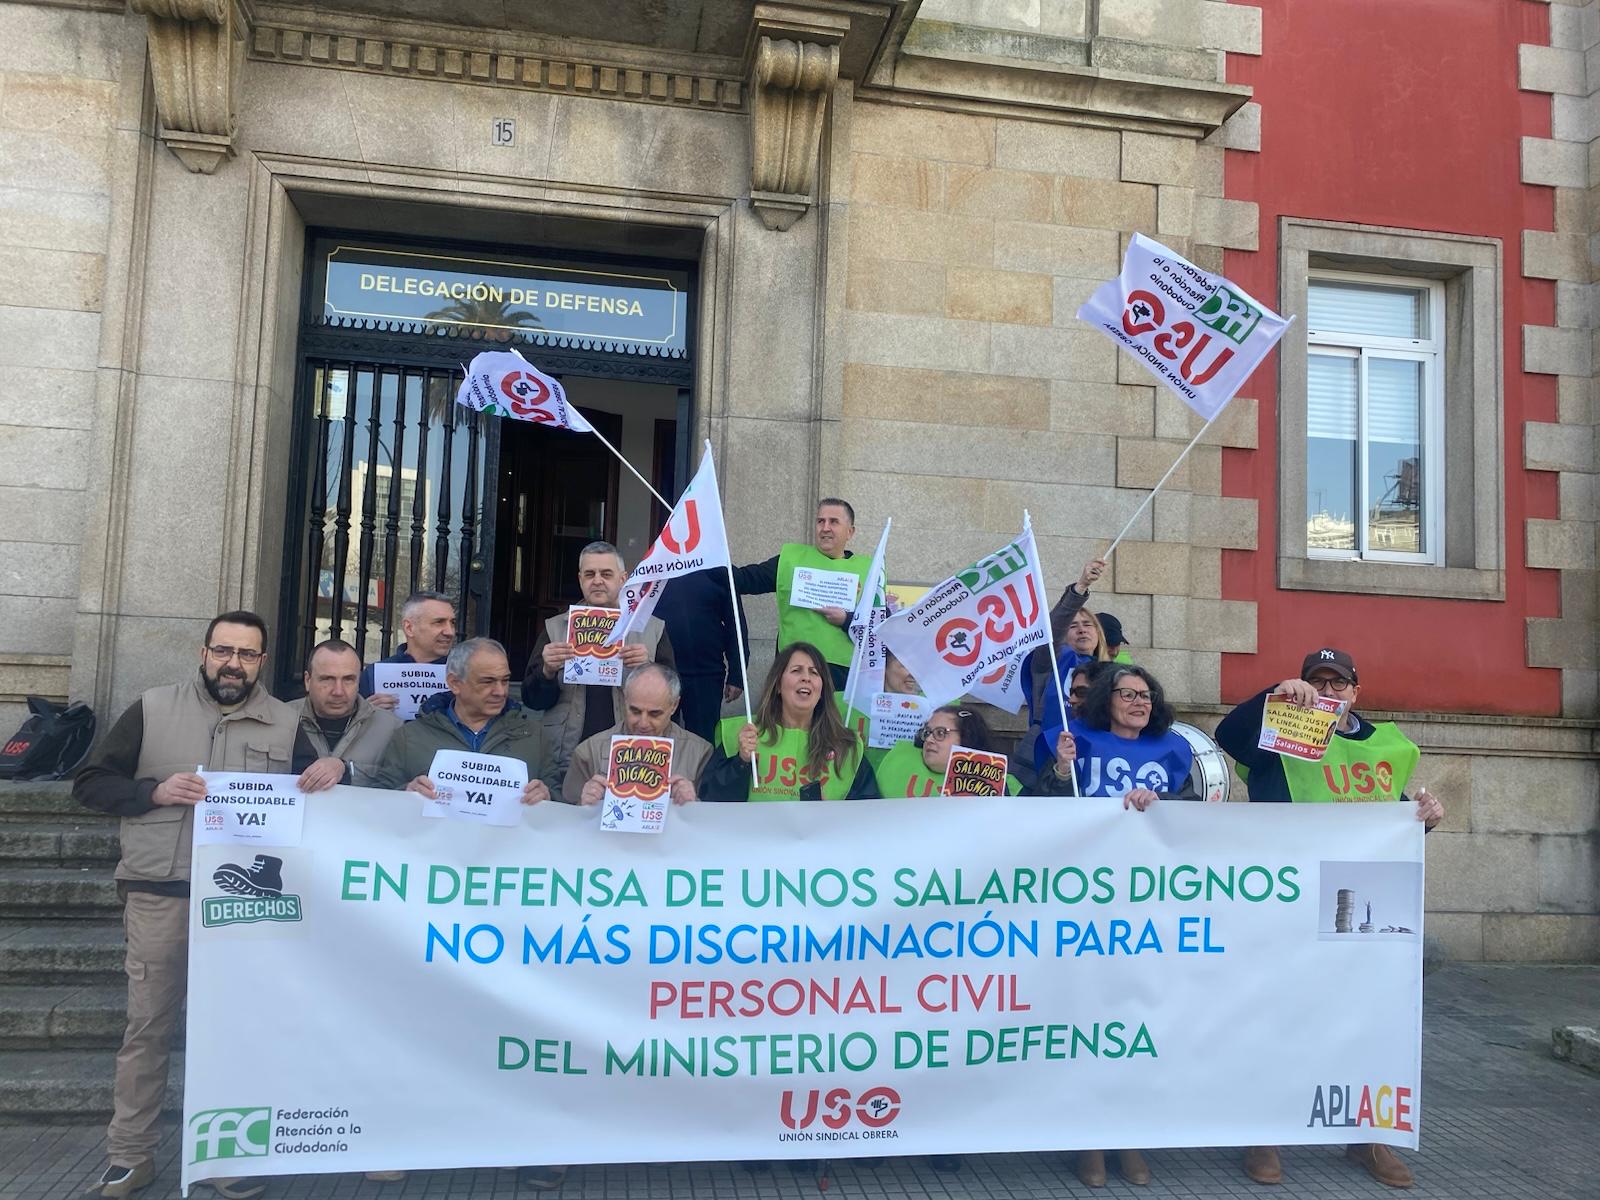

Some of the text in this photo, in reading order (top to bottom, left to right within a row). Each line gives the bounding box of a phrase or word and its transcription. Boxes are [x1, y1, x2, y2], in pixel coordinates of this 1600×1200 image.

[496, 121, 512, 142] 15
[360, 273, 644, 317] DELEGACIÓN DE DEFENSA
[574, 616, 614, 630] SALARIO
[576, 631, 608, 645] DIGNO
[598, 667, 618, 675] USO
[383, 681, 449, 689] CONSOLIDABL
[1267, 709, 1329, 728] SALARIAL JUSTA
[1276, 718, 1301, 729] LINEAL
[1303, 725, 1324, 735] PARA
[1276, 739, 1308, 753] Salarios
[616, 748, 668, 767] SALARIOS
[461, 761, 501, 773] SUBIDA
[954, 760, 1003, 781] SALARIOS
[437, 771, 520, 789] CONSOLIDABLE
[618, 766, 663, 787] DIGNOS
[1078, 756, 1169, 797] USO
[1323, 761, 1392, 794] USO
[229, 782, 274, 791] SUBIDA
[204, 795, 296, 806] CONSOLIDABLE
[465, 790, 493, 805] YA!
[236, 812, 267, 826] YA!
[641, 810, 663, 820] USO
[342, 860, 1300, 907] EN DEFENSA DE UNOS SALARIOS DIGNOS
[210, 900, 296, 920] DERECHOS
[425, 911, 1225, 965] NO MÁS DISCRIMINACIÓN PARA EL
[650, 974, 1031, 1019] PERSONAL CIVIL
[498, 1021, 1158, 1077] DEL MINISTERIO DE DEFENSA
[276, 1106, 349, 1120] Federación
[780, 1086, 901, 1130] USO
[1307, 1085, 1413, 1132] APLAGE
[275, 1124, 362, 1137] Atención a la
[779, 1130, 899, 1142] UNIÓN SINDICAL OBRERA
[274, 1140, 348, 1154] Ciudadanía
